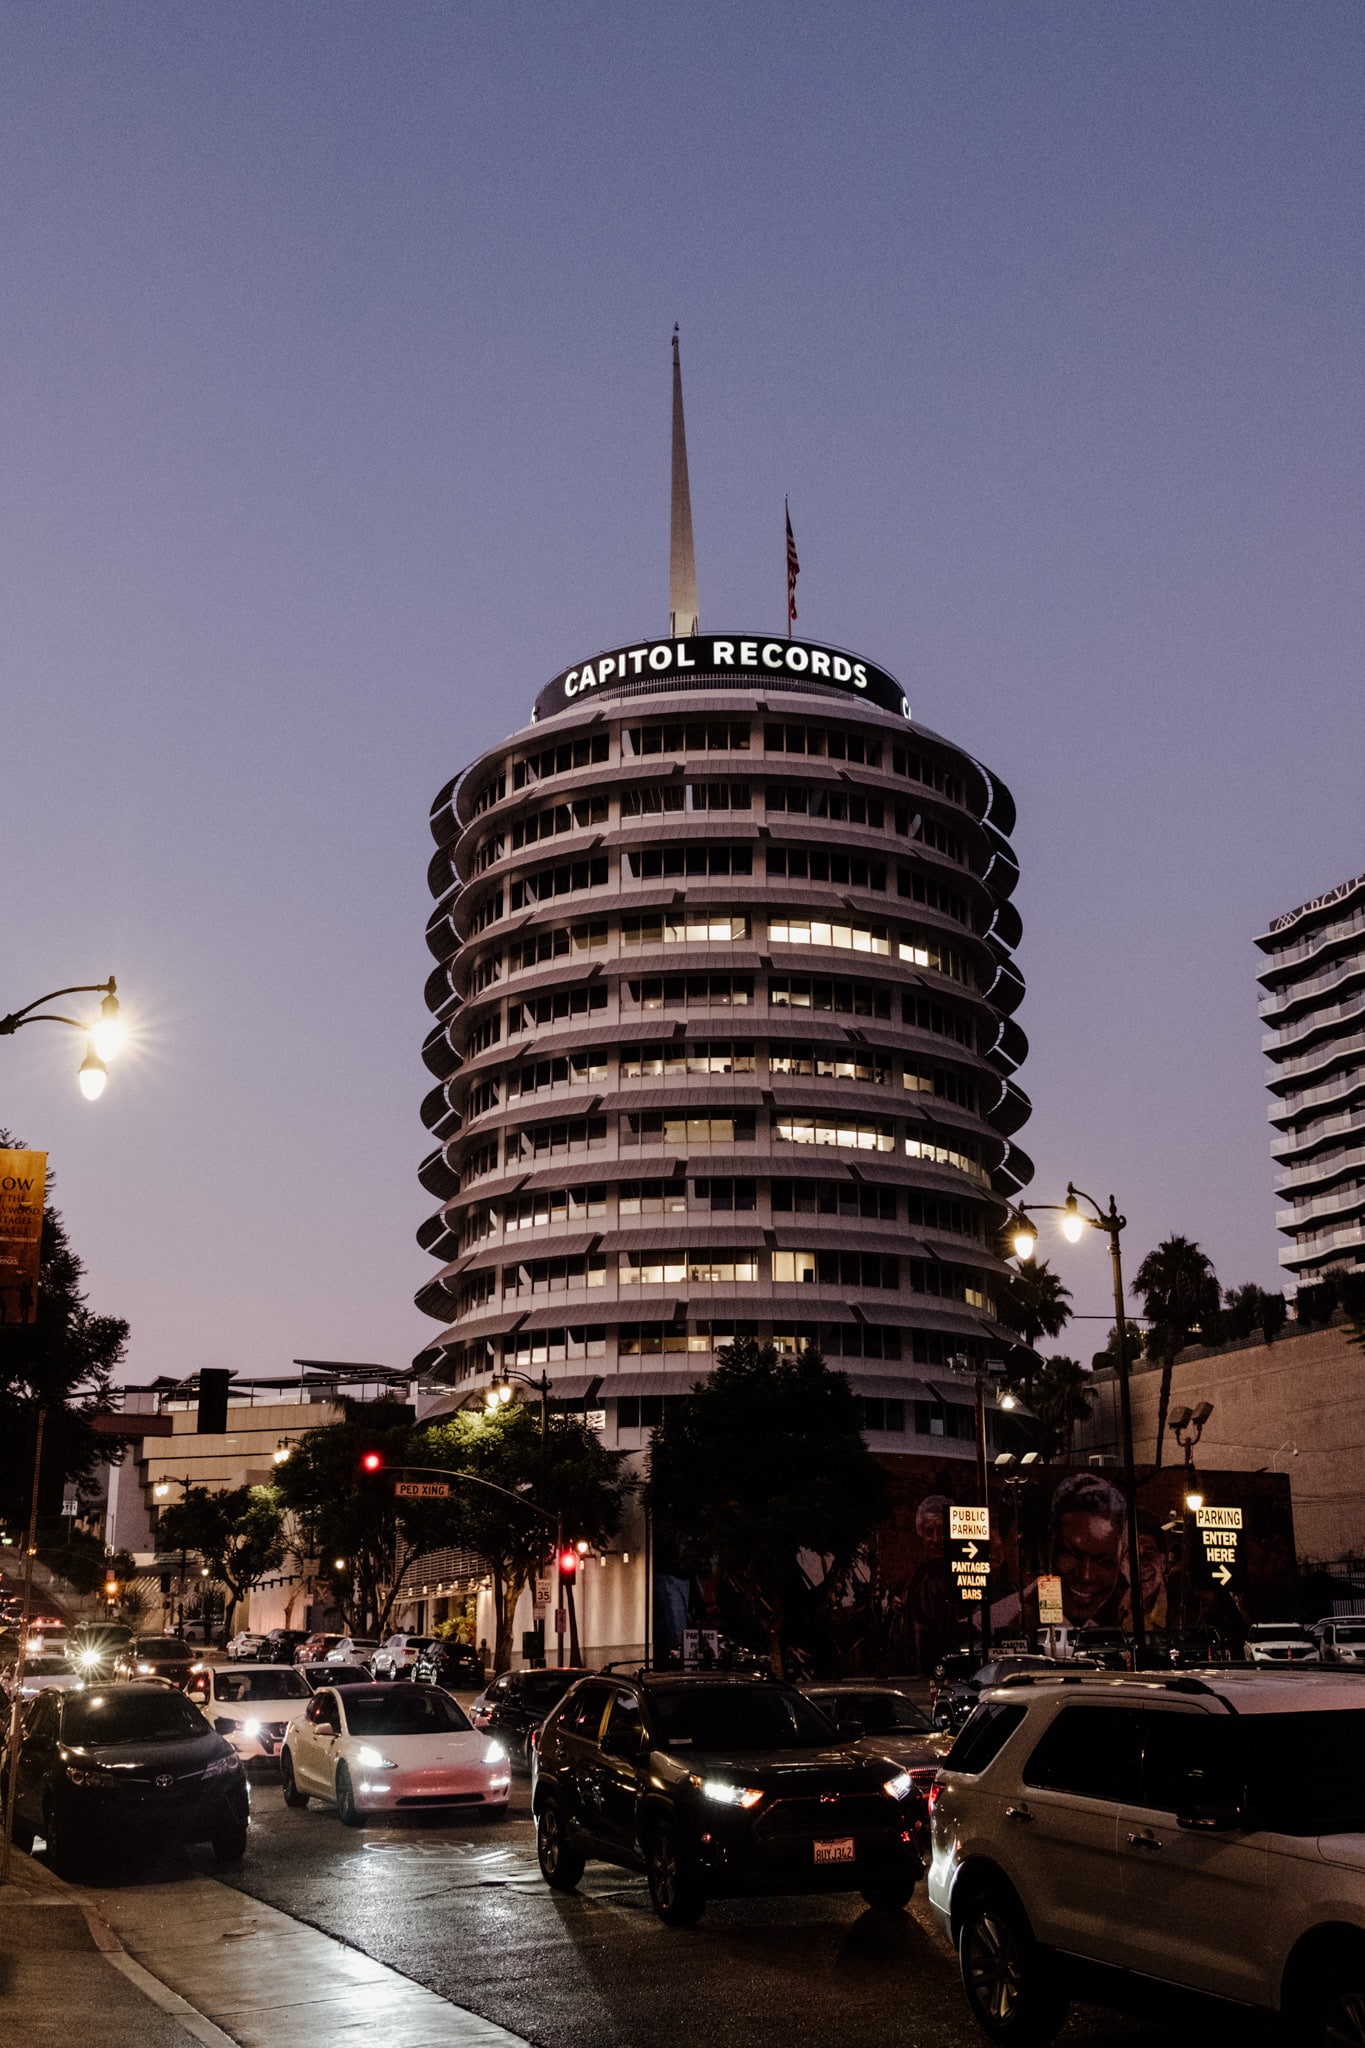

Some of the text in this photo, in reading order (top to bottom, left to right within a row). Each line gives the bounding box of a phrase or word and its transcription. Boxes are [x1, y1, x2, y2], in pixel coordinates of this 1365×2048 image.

[564, 641, 868, 697] CAPITOL RECORDS
[400, 1485, 445, 1496] PED XING
[952, 1510, 986, 1522] PUBLIC
[1198, 1510, 1240, 1526] PARKING
[951, 1524, 987, 1536] PARKING
[1202, 1530, 1238, 1546] ENTER
[1206, 1547, 1236, 1563] HERE
[951, 1561, 991, 1574] PANTAGES
[956, 1574, 987, 1587] AVALON
[537, 1591, 550, 1600] 35
[961, 1588, 983, 1600] BARS
[686, 1632, 715, 1640] PANAGES
[816, 1847, 852, 1861] 8UYJ342
